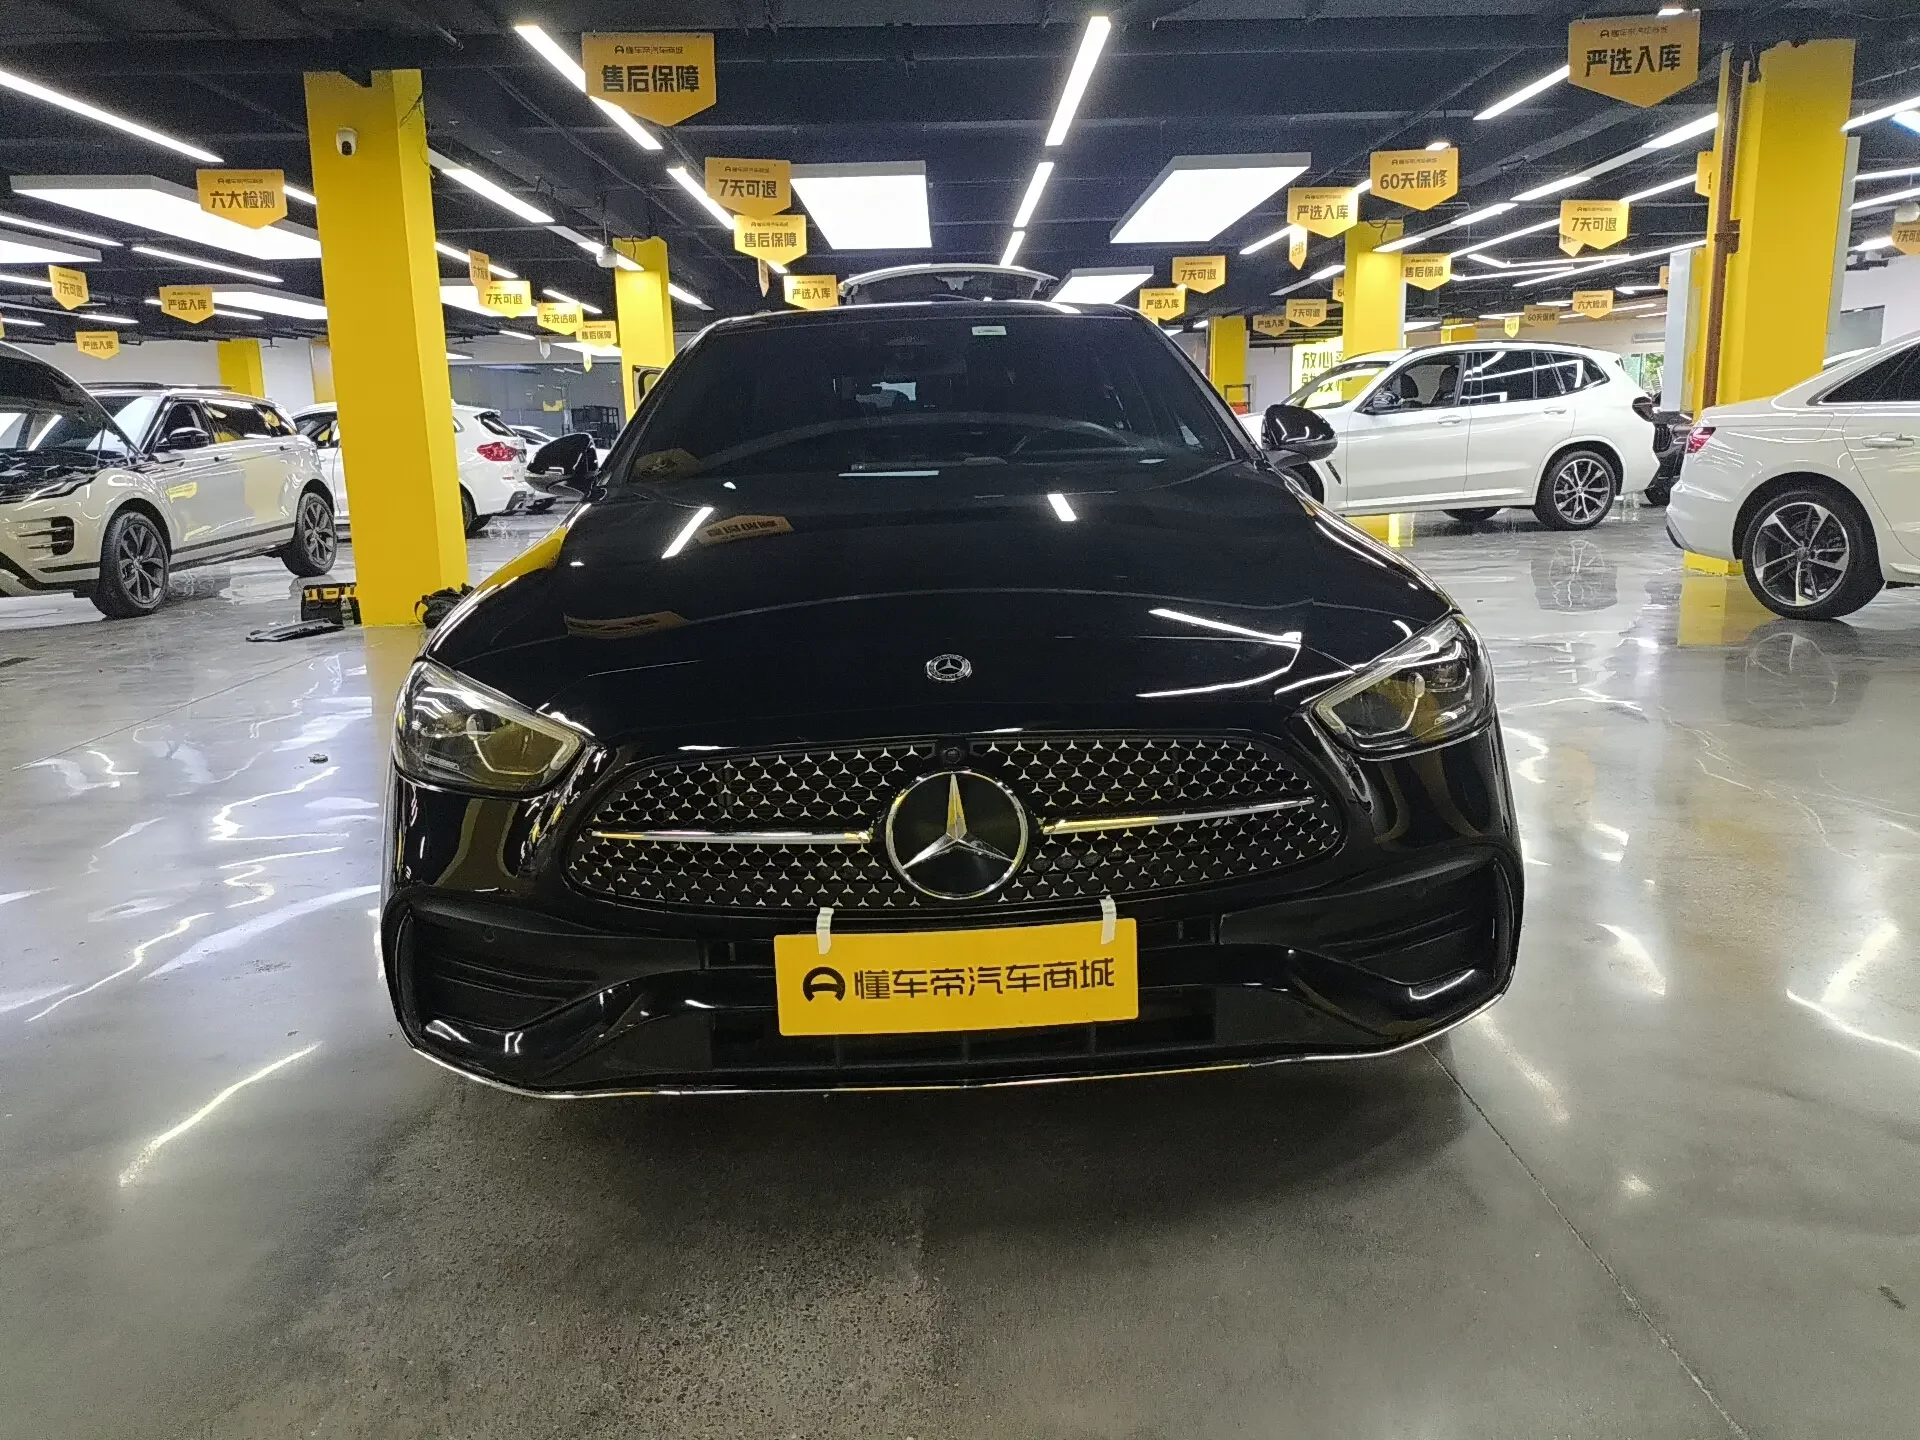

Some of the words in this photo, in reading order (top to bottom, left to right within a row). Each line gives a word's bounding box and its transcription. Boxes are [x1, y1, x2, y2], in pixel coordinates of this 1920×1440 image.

[1585, 43, 1682, 78] 严选入库
[601, 64, 700, 93] 售后保障
[1379, 169, 1449, 190] 60天保修
[718, 178, 778, 198] 7天可退
[209, 190, 276, 209] 六大检测
[1296, 204, 1349, 221] 严选入库
[1571, 217, 1618, 232] 7天可退
[743, 232, 798, 248] 售后保障
[1896, 229, 1920, 243] 7天可
[1180, 268, 1217, 281] 7天可退
[485, 293, 523, 305] 7天可退
[791, 287, 831, 300] 严选入库
[167, 298, 208, 311] 严选入库
[1145, 298, 1180, 310] 严选入库
[542, 313, 578, 324] 车况透明
[1292, 308, 1321, 318] 7天可退
[82, 340, 114, 351] 严选入库
[854, 958, 1115, 1000] 懂车帝汽车商城
